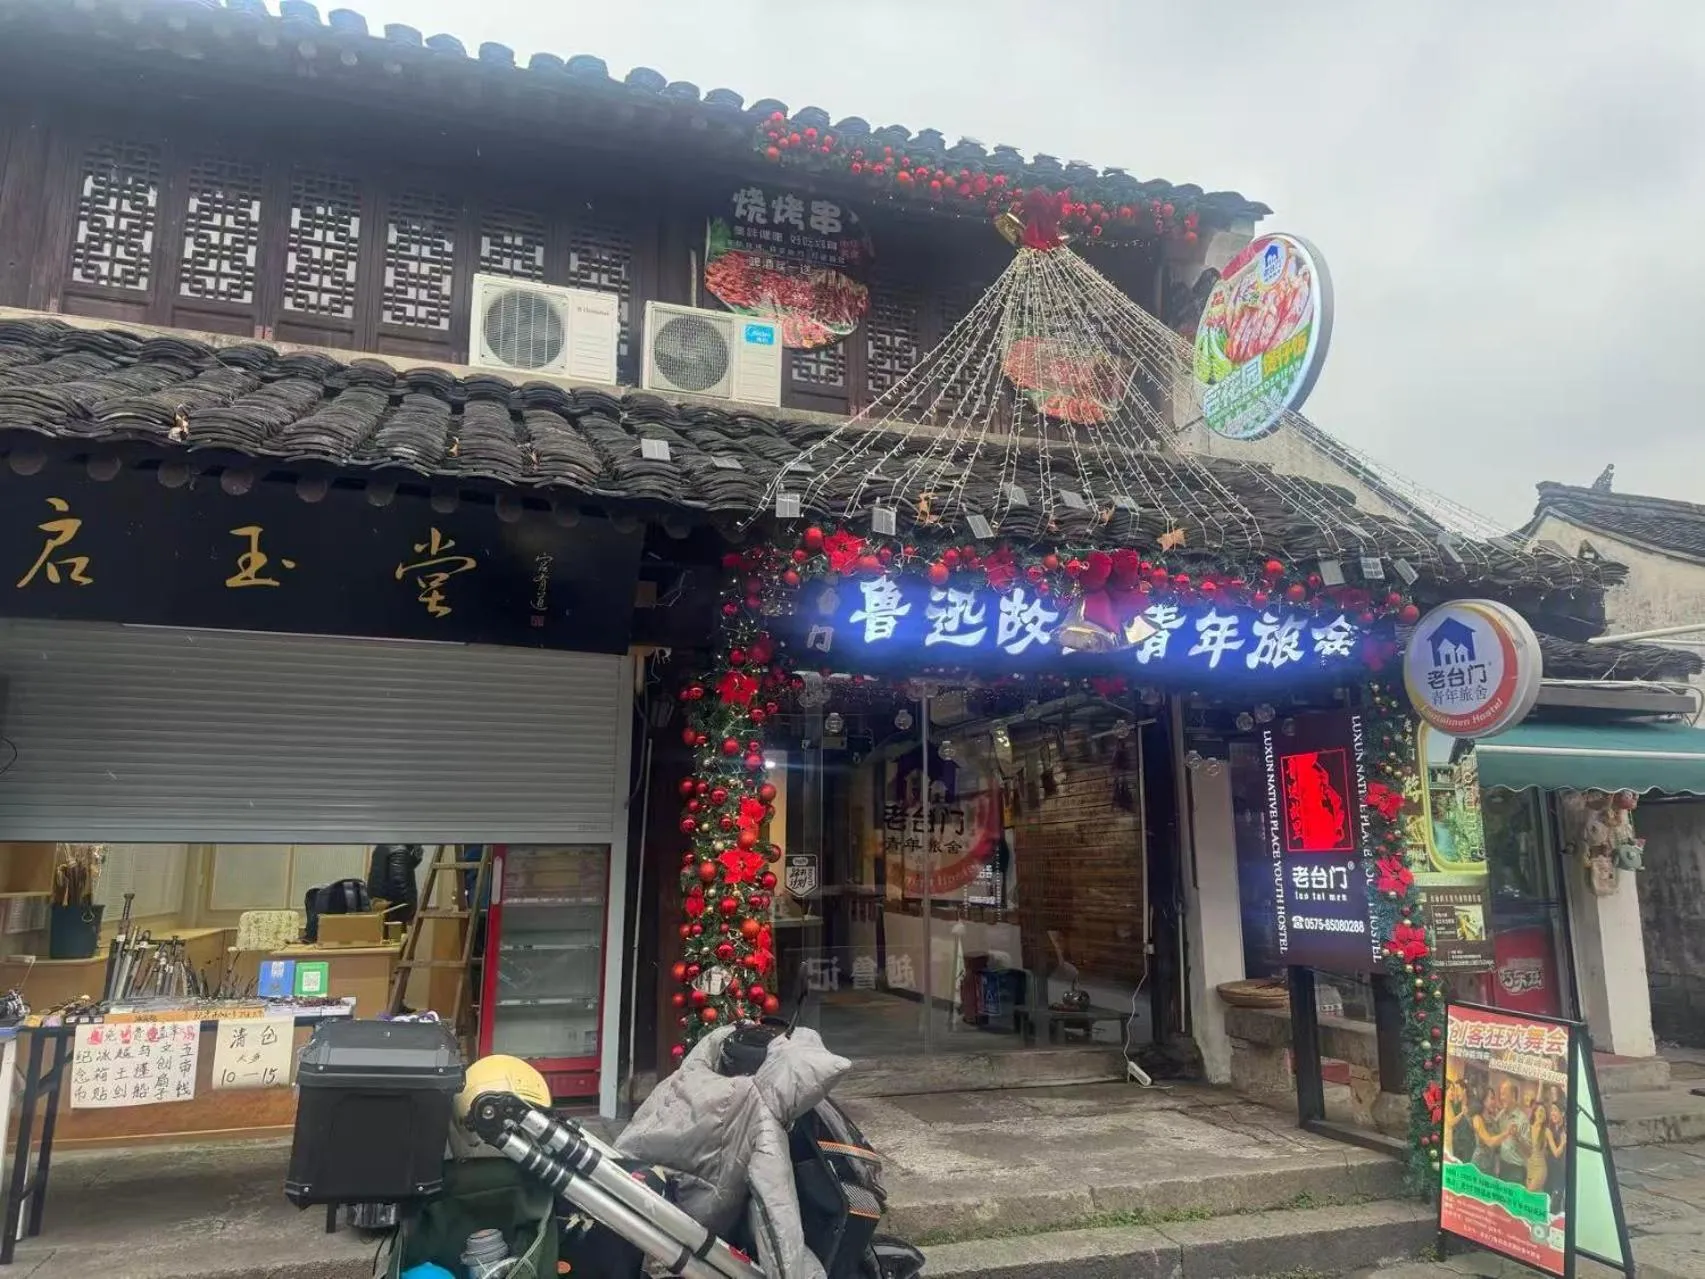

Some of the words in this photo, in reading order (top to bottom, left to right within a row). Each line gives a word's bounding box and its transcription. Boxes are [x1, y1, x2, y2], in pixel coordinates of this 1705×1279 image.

[733, 187, 843, 235] 烧烤串
[850, 575, 1356, 670] 鲁迅故青年旅舍
[1428, 664, 1487, 689] 老台门
[1433, 685, 1488, 705] 青年旅舍
[1263, 730, 1274, 772] LUXUN
[1266, 773, 1279, 819] NATIVE
[1270, 820, 1281, 858] PLACE
[1273, 860, 1285, 903] YOUTH
[1292, 865, 1348, 889] 老台门
[1277, 906, 1289, 954] HOSTEL
[1448, 1022, 1567, 1056] 创客狂欢舞会
